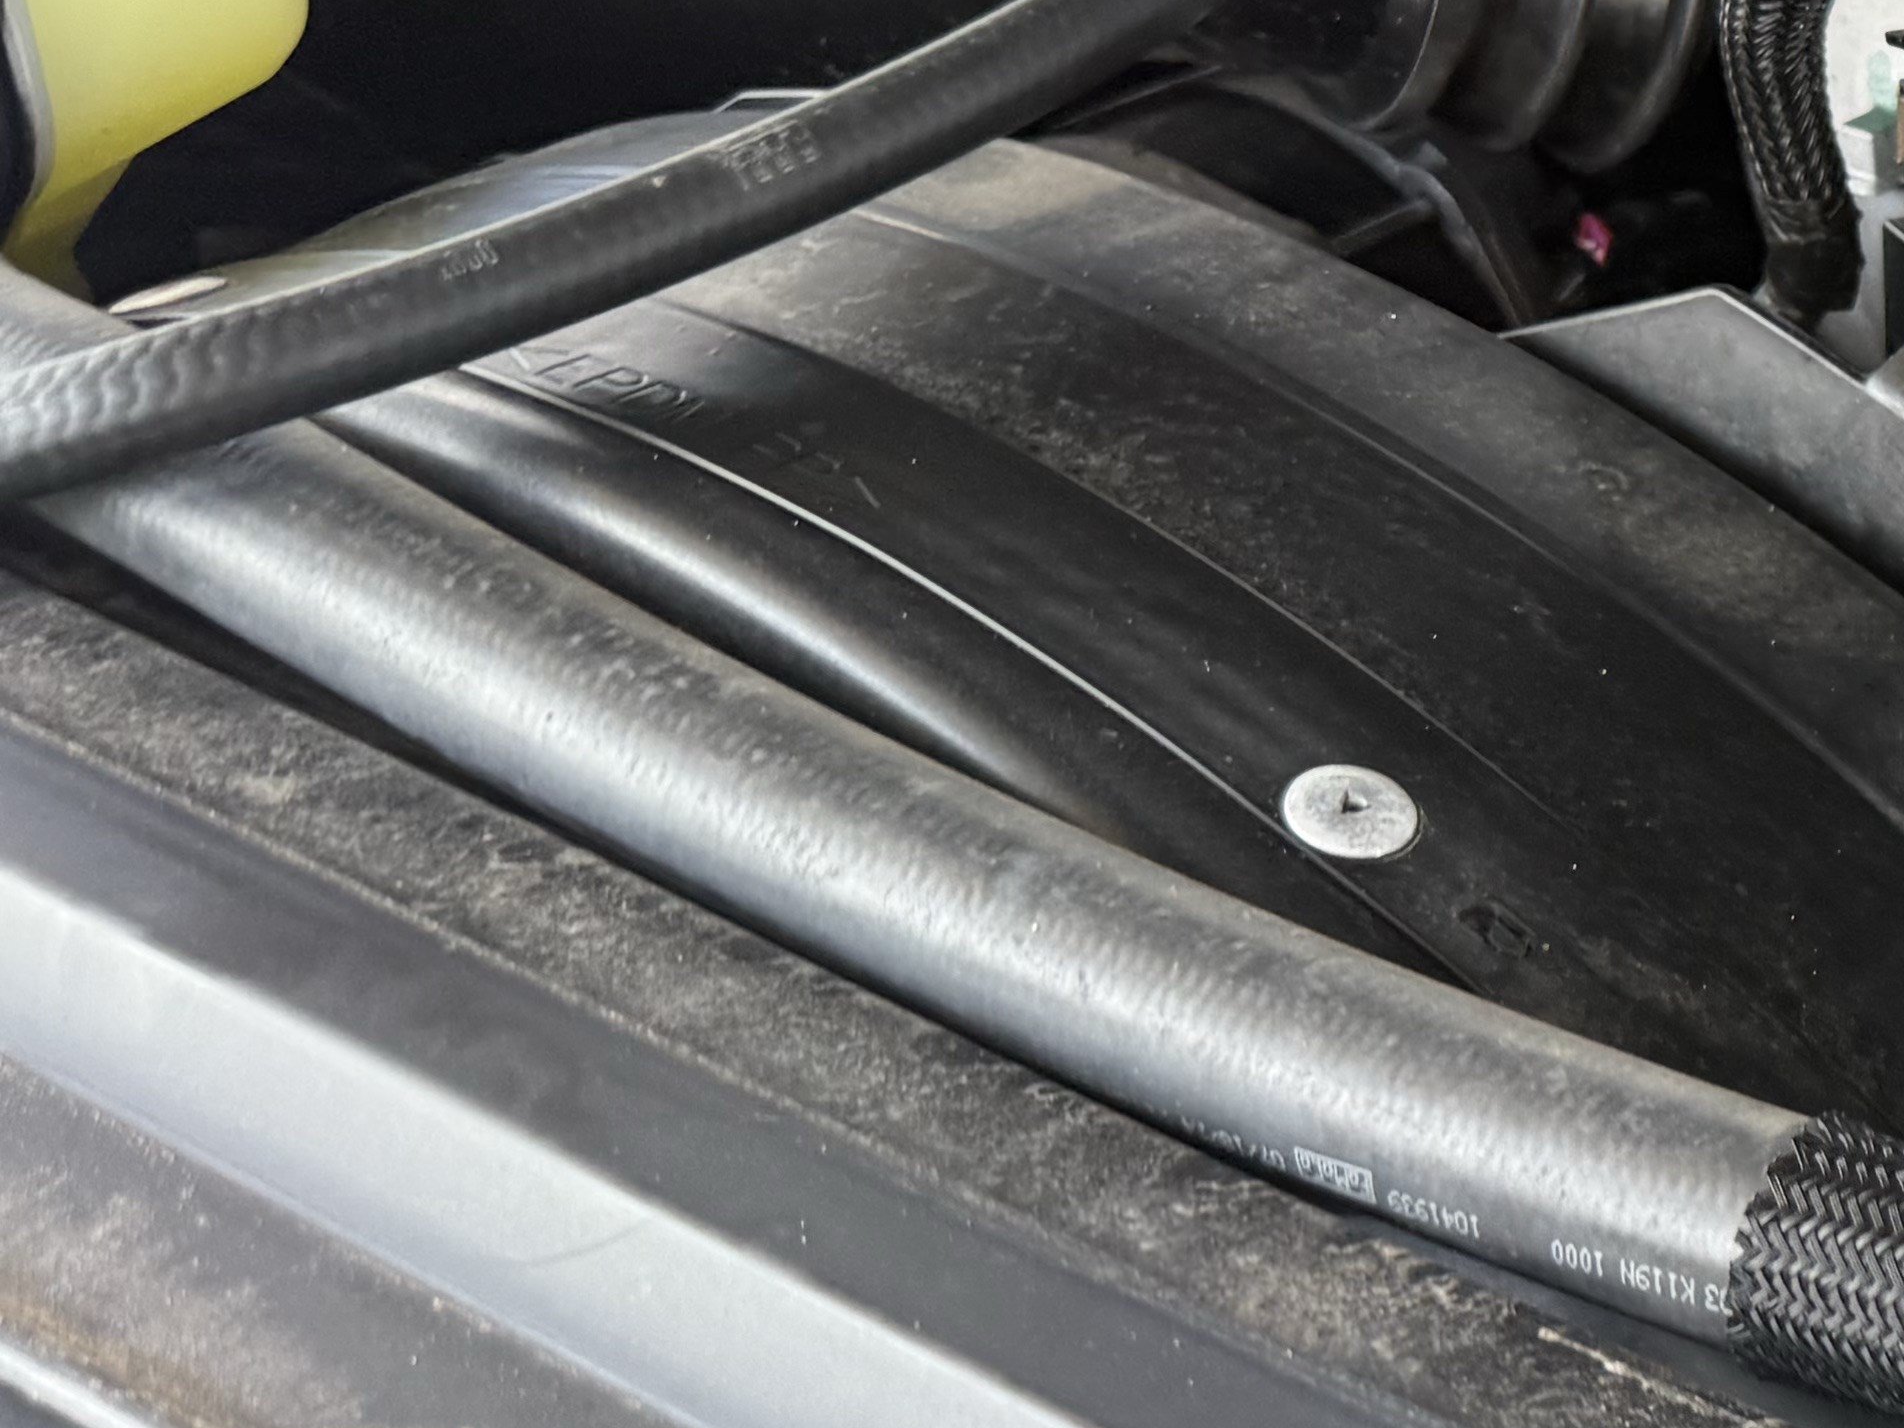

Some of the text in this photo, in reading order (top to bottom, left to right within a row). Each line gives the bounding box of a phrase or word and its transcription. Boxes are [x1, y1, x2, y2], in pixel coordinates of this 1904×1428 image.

[1386, 1187, 1481, 1239] 1041939
[1550, 1237, 1605, 1277] 1000
[1619, 1256, 1696, 1307] K119N
